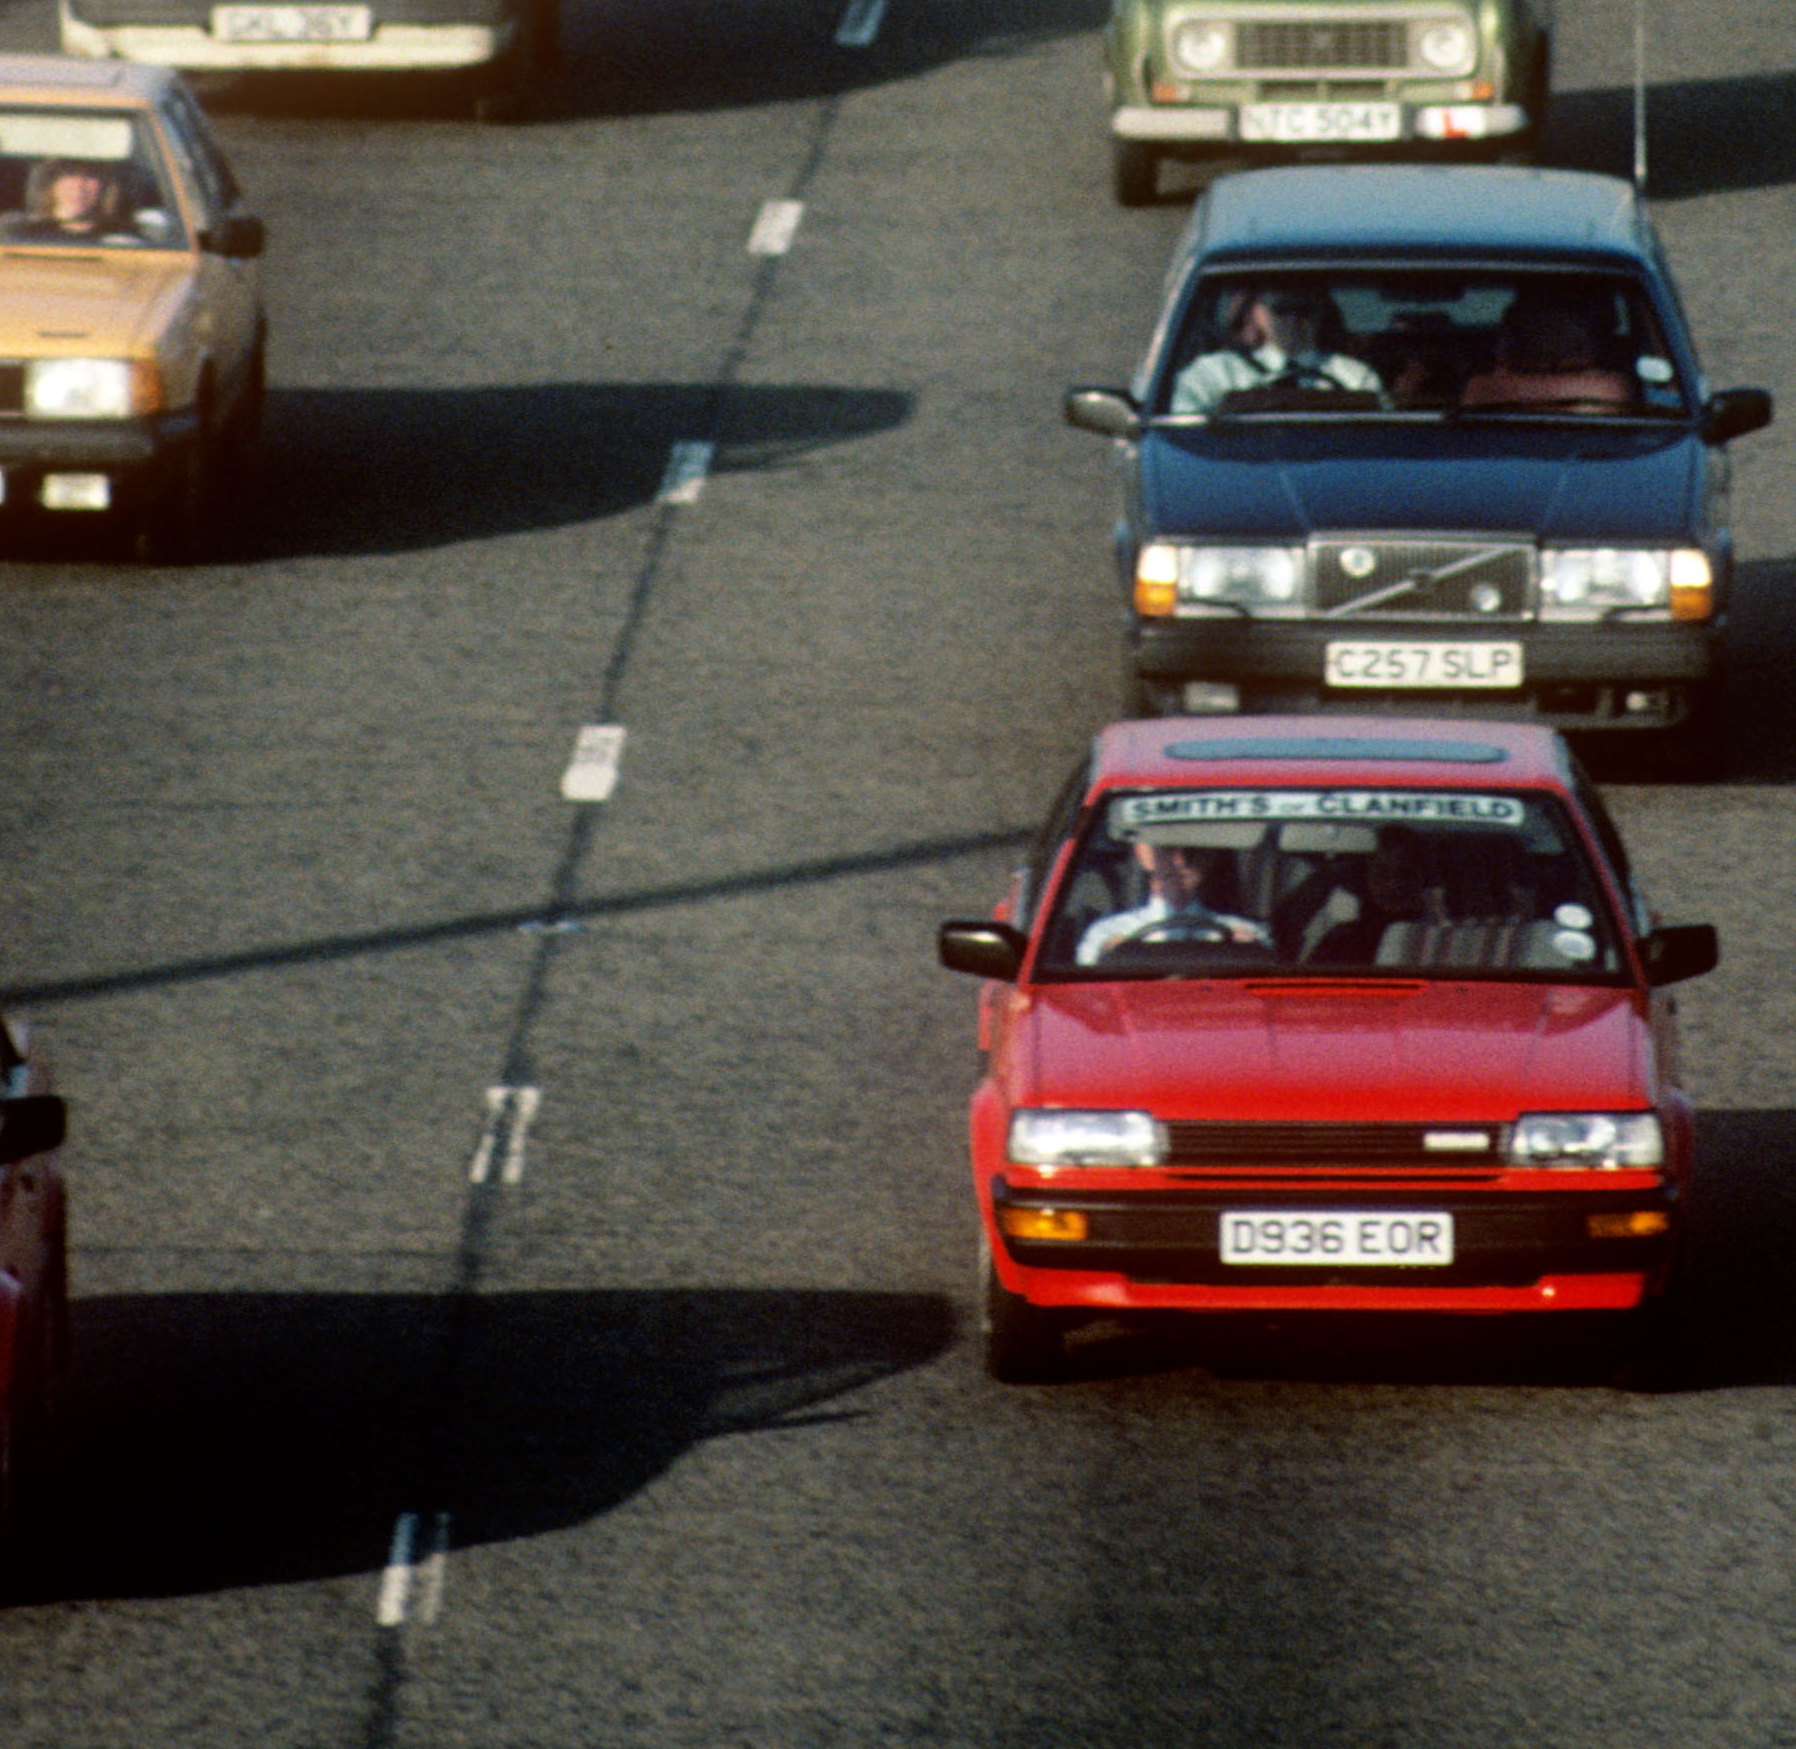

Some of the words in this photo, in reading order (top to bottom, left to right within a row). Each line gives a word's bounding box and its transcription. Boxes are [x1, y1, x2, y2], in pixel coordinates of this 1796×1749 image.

[1442, 107, 1470, 139] L
[1337, 649, 1430, 679] C257
[1443, 649, 1512, 679] SLP
[1314, 793, 1514, 821] CLANFIELD
[1231, 1219, 1345, 1255] D936
[1357, 1219, 1442, 1255] EOR
